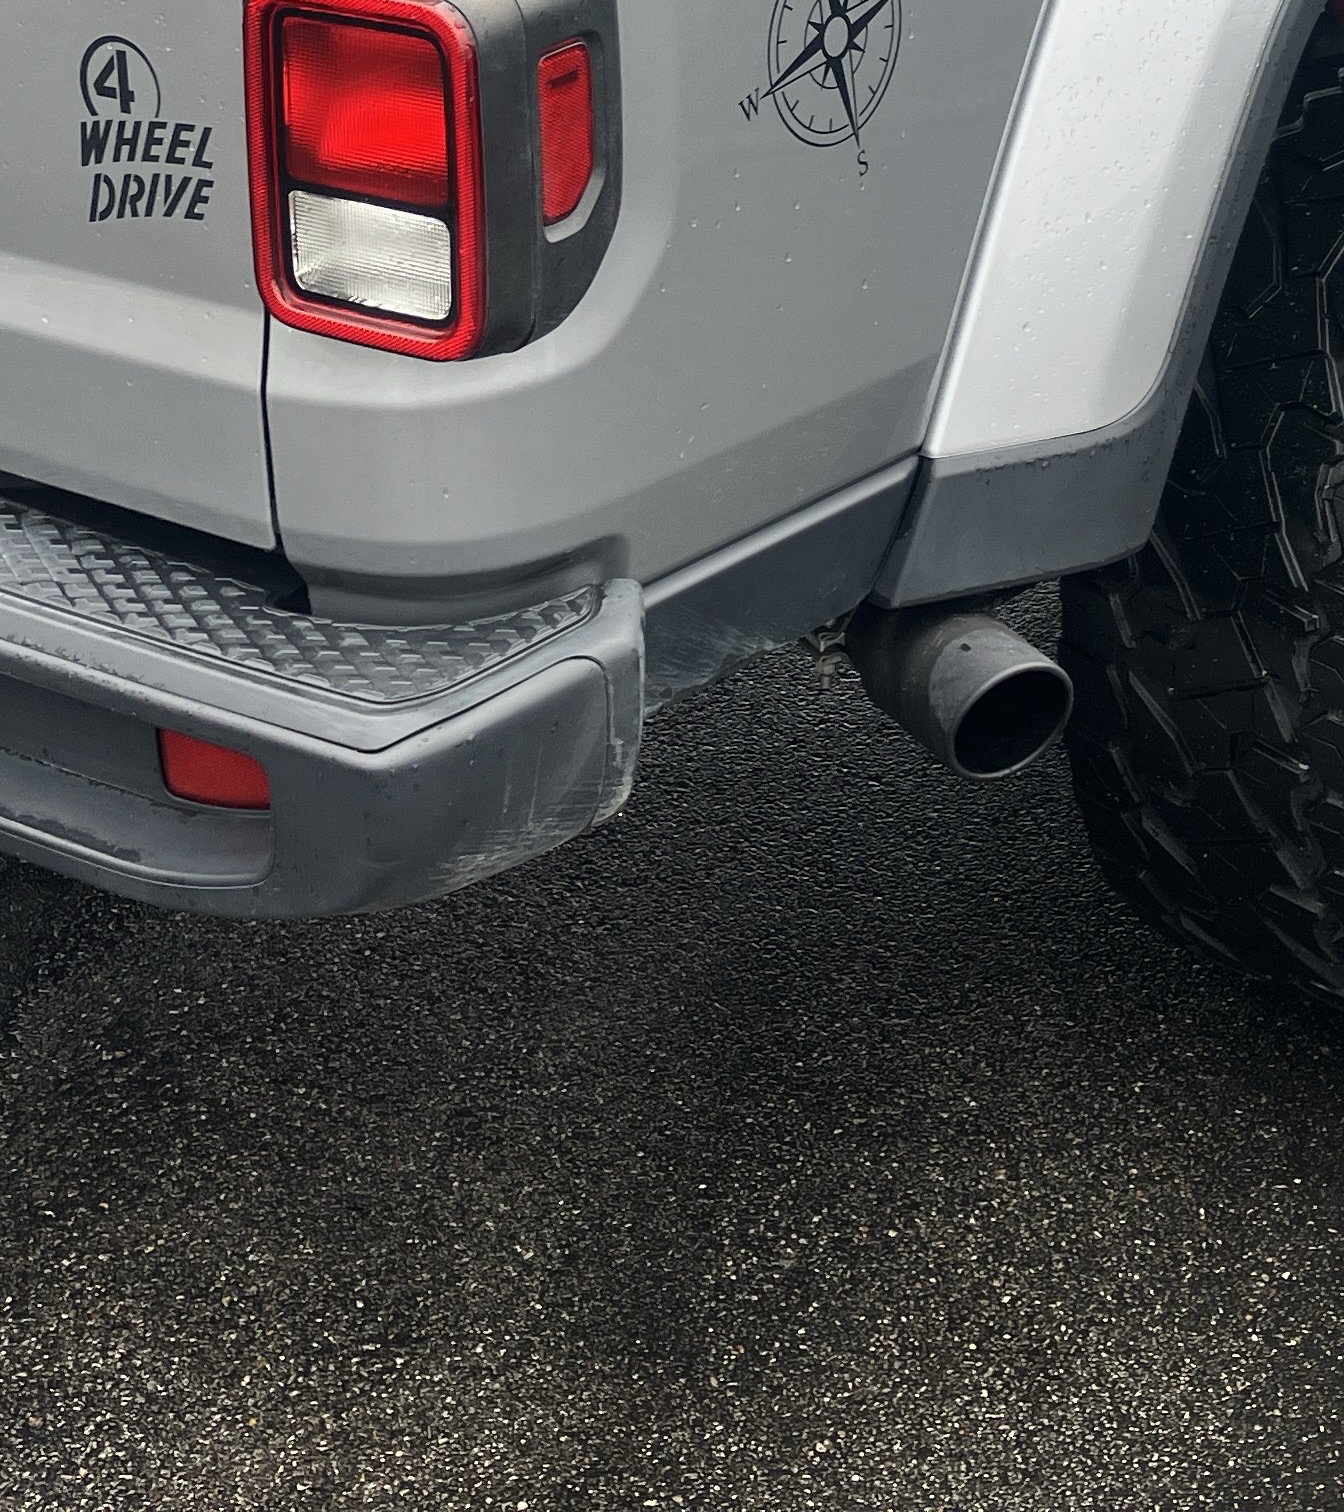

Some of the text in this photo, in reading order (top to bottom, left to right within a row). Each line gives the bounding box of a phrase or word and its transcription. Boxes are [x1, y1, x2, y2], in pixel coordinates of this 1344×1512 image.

[93, 49, 135, 115] 4
[738, 87, 760, 122] W
[80, 119, 214, 169] WHEEL
[856, 149, 869, 177] S
[89, 172, 215, 223] DRIVE
